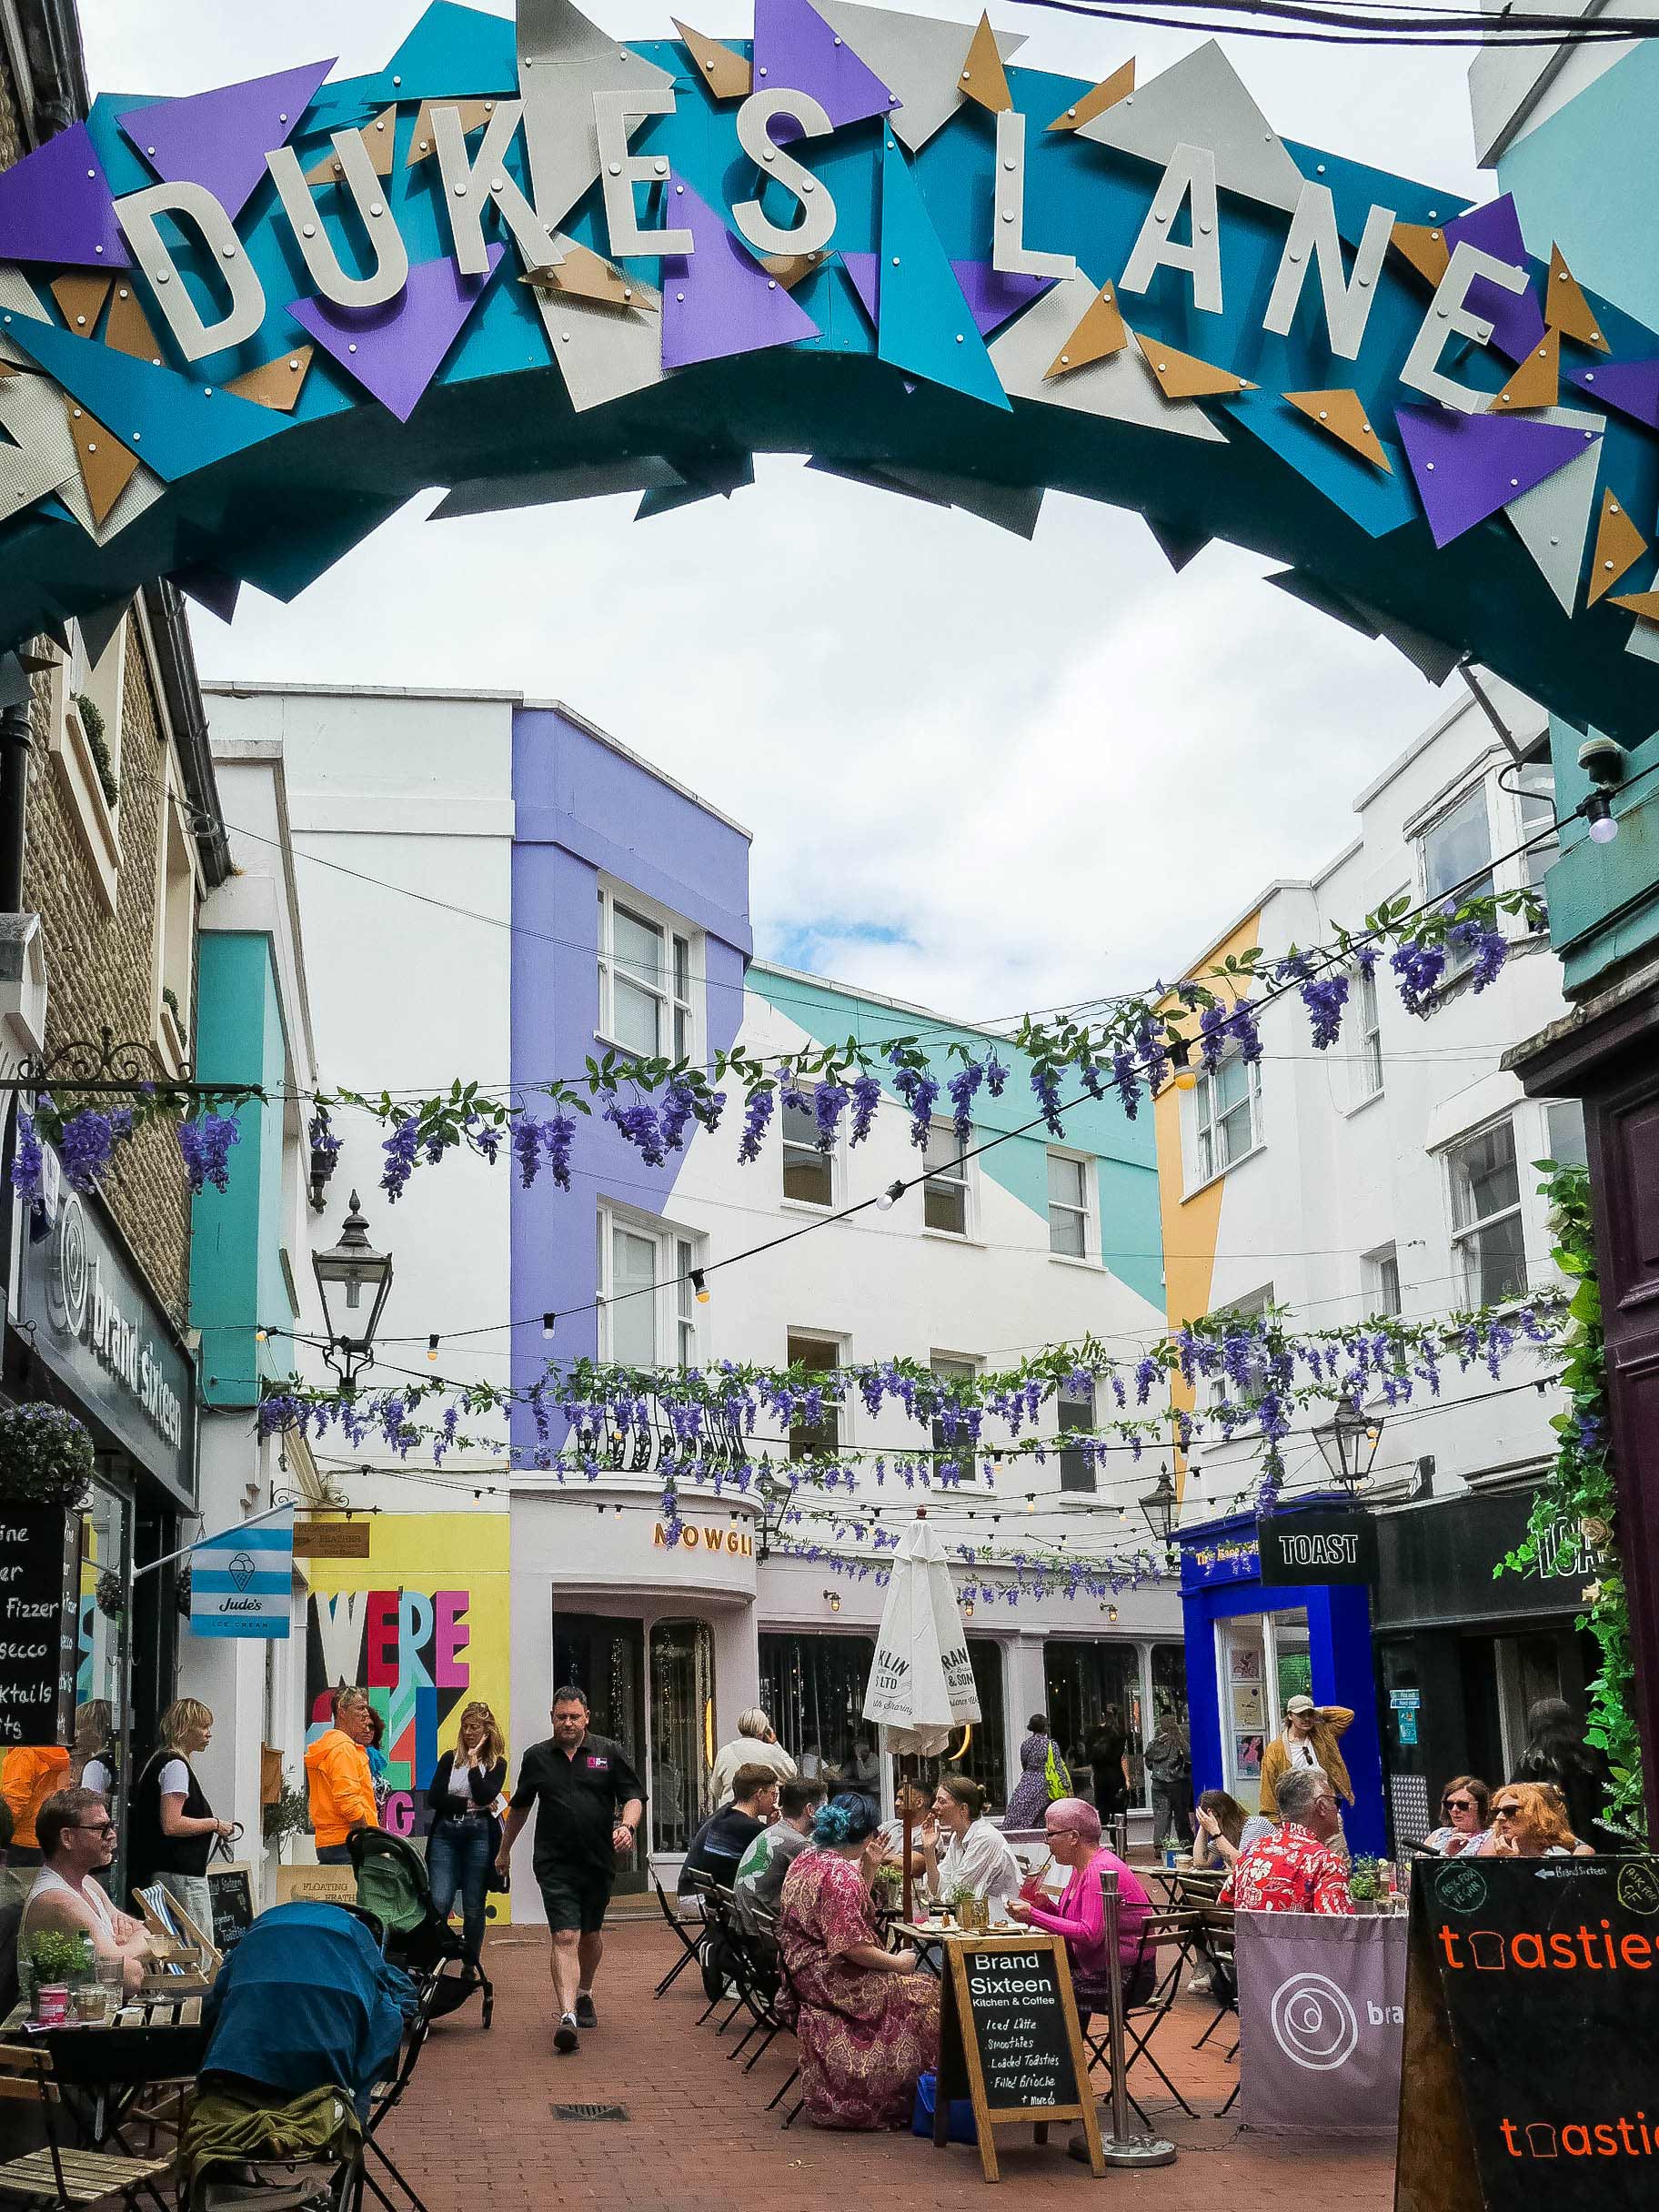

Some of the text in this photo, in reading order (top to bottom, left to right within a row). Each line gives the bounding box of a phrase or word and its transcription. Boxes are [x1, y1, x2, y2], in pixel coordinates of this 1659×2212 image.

[112, 88, 1529, 414] DUKES LANE
[94, 1254, 181, 1451] brand sixteen
[1279, 1534, 1359, 1564] TOAST
[6, 1597, 59, 1618] Fizzer
[218, 1597, 263, 1612] Jude's
[949, 1675, 957, 1687] &
[1626, 1867, 1645, 1889] ASK
[303, 1883, 347, 1891] FLOATING
[975, 1953, 1040, 1970] Brand
[970, 1977, 1051, 1994] Sixteen
[972, 1996, 1055, 2007] Kitchen & Coffee
[1367, 2000, 1404, 2025] bra
[987, 2018, 1010, 2031] Iced
[988, 2036, 1034, 2050] Smoothies
[991, 2053, 1060, 2068] Loaded Toasties
[994, 2074, 1055, 2088] Filled Brioche
